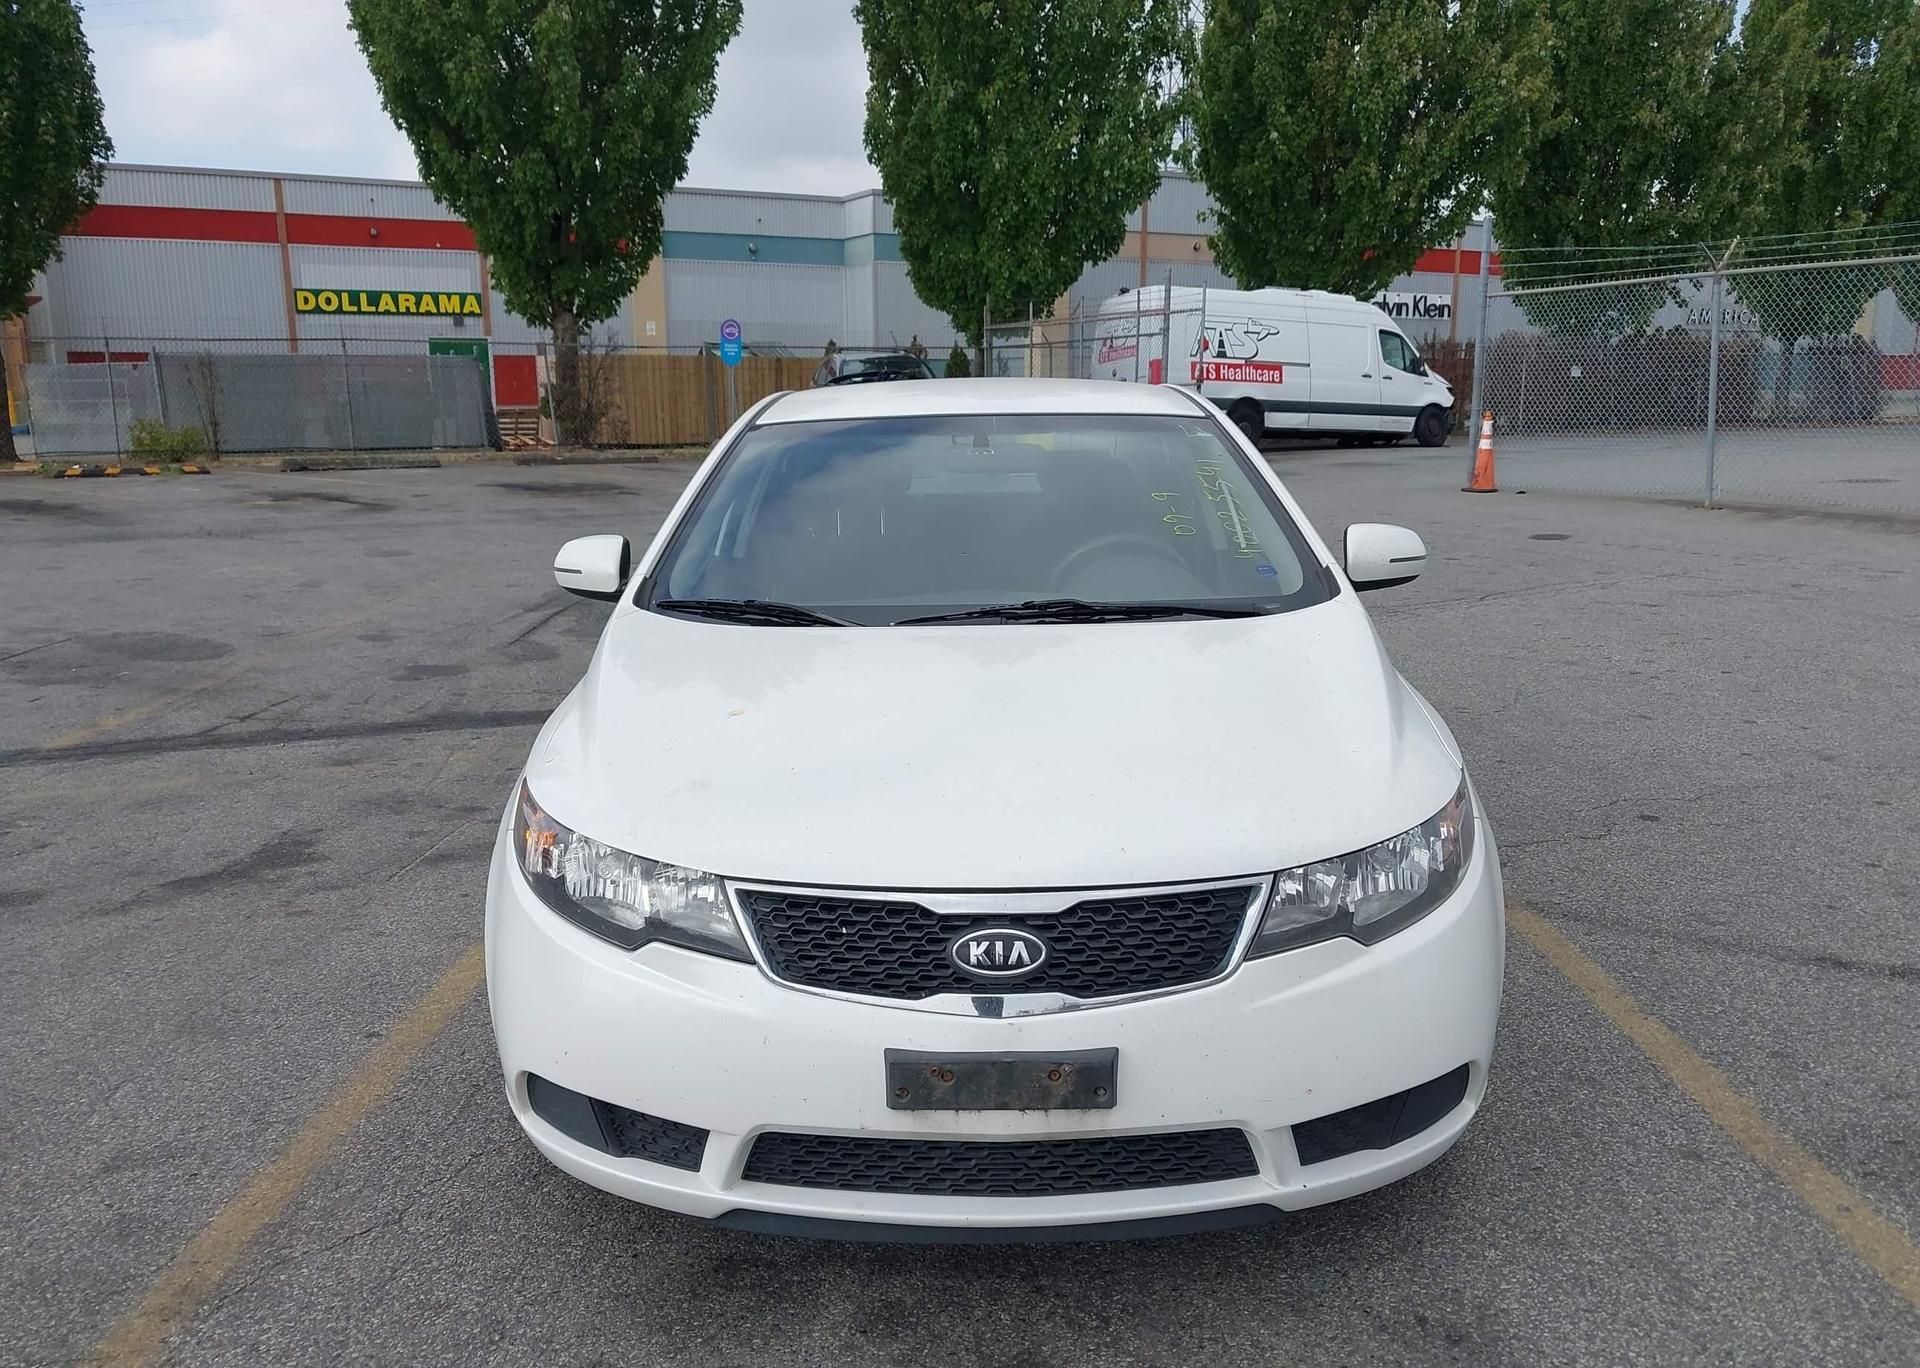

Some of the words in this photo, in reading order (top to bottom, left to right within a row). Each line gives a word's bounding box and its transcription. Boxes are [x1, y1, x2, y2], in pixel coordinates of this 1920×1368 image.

[296, 290, 481, 314] DOLLARAMA
[1412, 295, 1451, 318] Klein
[1687, 308, 1760, 325] AMRICA
[1219, 364, 1280, 382] Healthcare
[968, 941, 1031, 966] KIA
